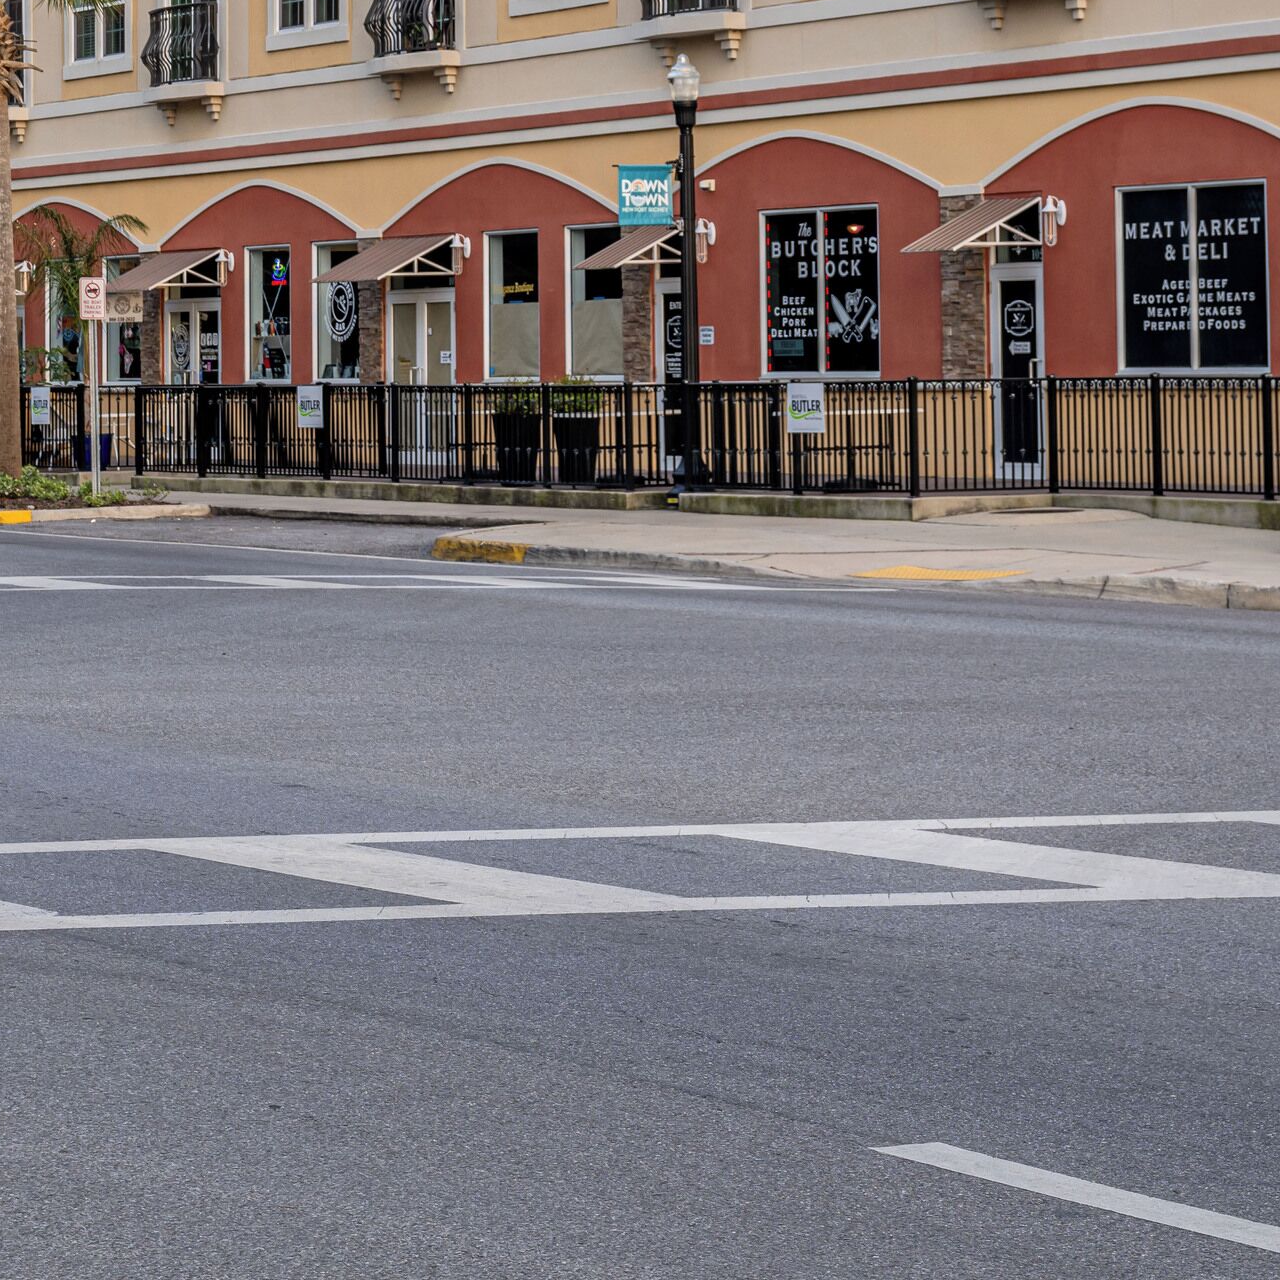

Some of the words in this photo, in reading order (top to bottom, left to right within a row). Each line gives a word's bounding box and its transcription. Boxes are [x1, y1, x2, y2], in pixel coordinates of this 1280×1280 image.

[621, 178, 668, 193] DOWN
[621, 192, 668, 207] TOWN
[798, 221, 812, 237] The
[1125, 221, 1174, 240] MEAT
[771, 236, 878, 259] BUTCHER'S
[1164, 243, 1177, 261] &
[797, 259, 862, 279] BLOCK
[1198, 278, 1229, 289] BEEF
[782, 295, 806, 306] BEEF
[1133, 292, 1174, 305] EXOTIC
[1216, 290, 1256, 303] MEATS
[773, 306, 815, 317] CHICKEN
[1147, 306, 1179, 318] MEAT
[782, 317, 807, 327] PORK
[1207, 318, 1247, 330] FOODS
[771, 329, 792, 338] DELI
[300, 399, 321, 412] BUTLER
[791, 399, 822, 413] BUTLER
